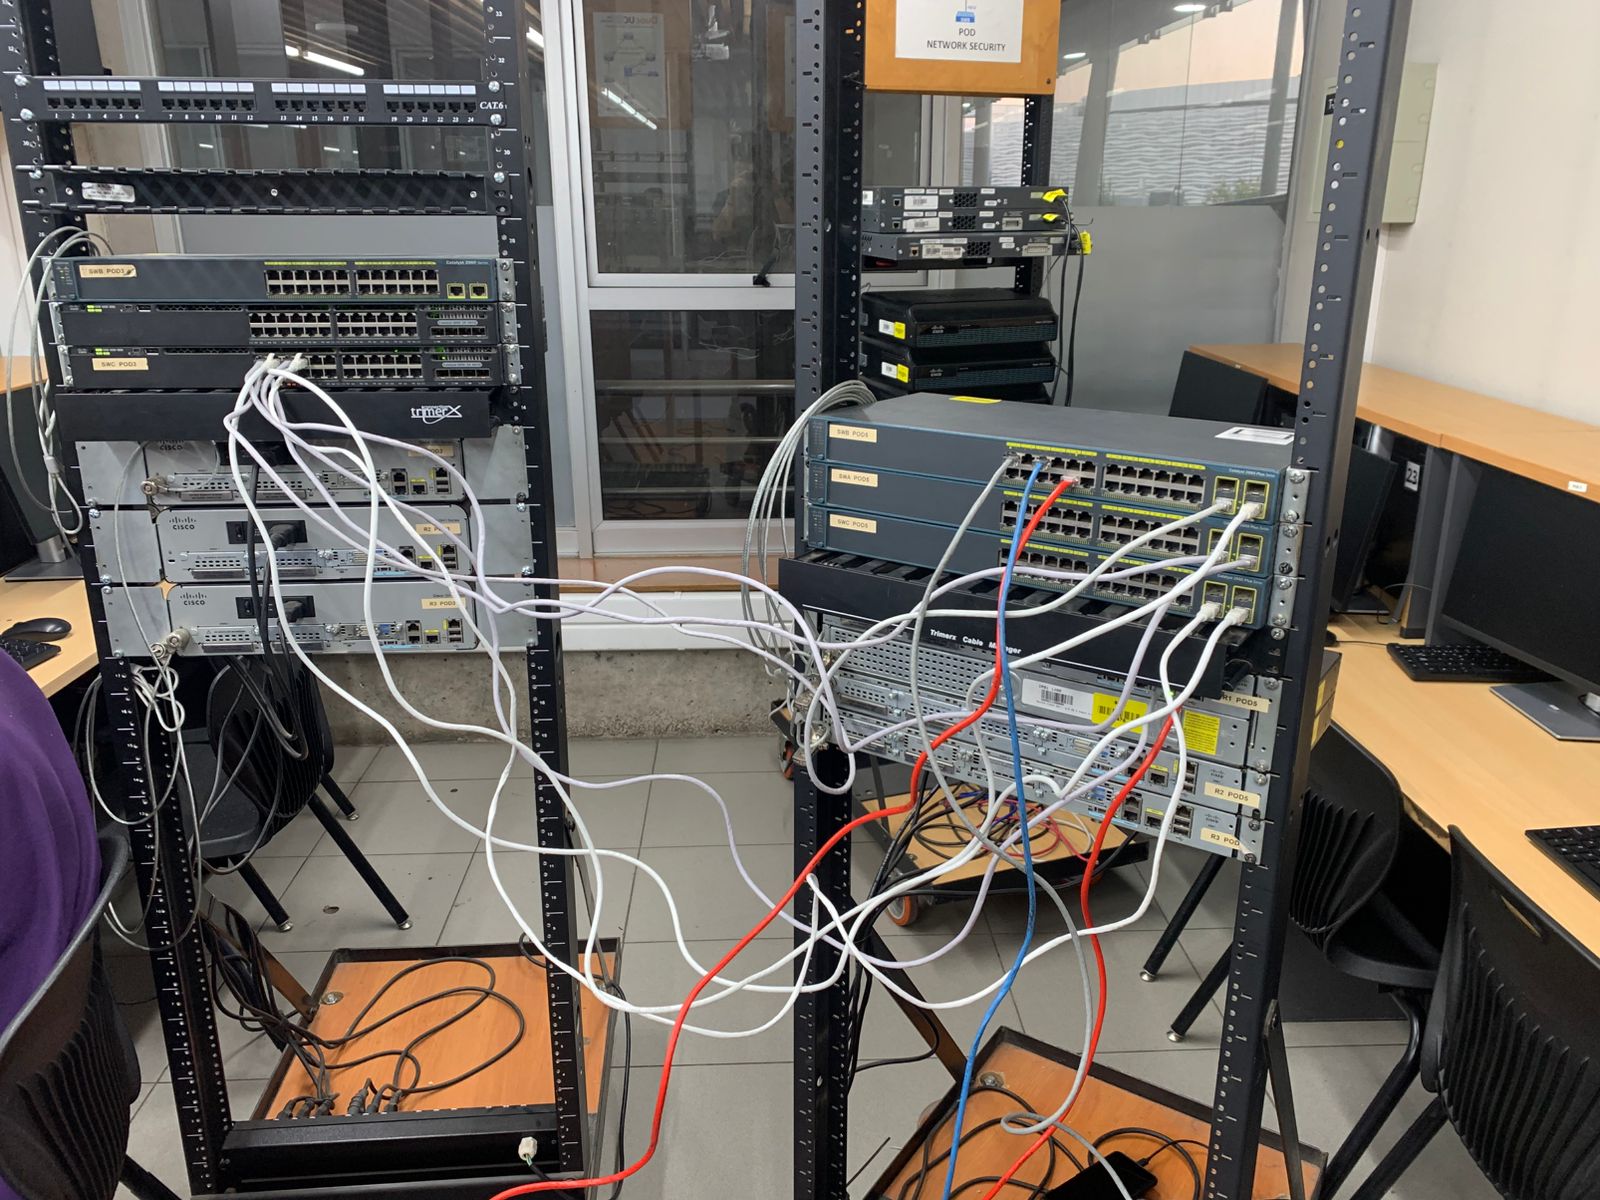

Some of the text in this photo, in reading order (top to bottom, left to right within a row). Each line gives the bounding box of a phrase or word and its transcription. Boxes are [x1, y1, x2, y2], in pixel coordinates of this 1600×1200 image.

[958, 27, 976, 37] POD
[926, 40, 1006, 52] NETWORK SECURITY
[1406, 467, 1418, 485] 23
[930, 628, 957, 641] Trimerx
[962, 636, 984, 647] Cable
[1235, 697, 1258, 707] POD5
[1214, 787, 1249, 802] R2 POD5
[1210, 833, 1220, 841] R3
